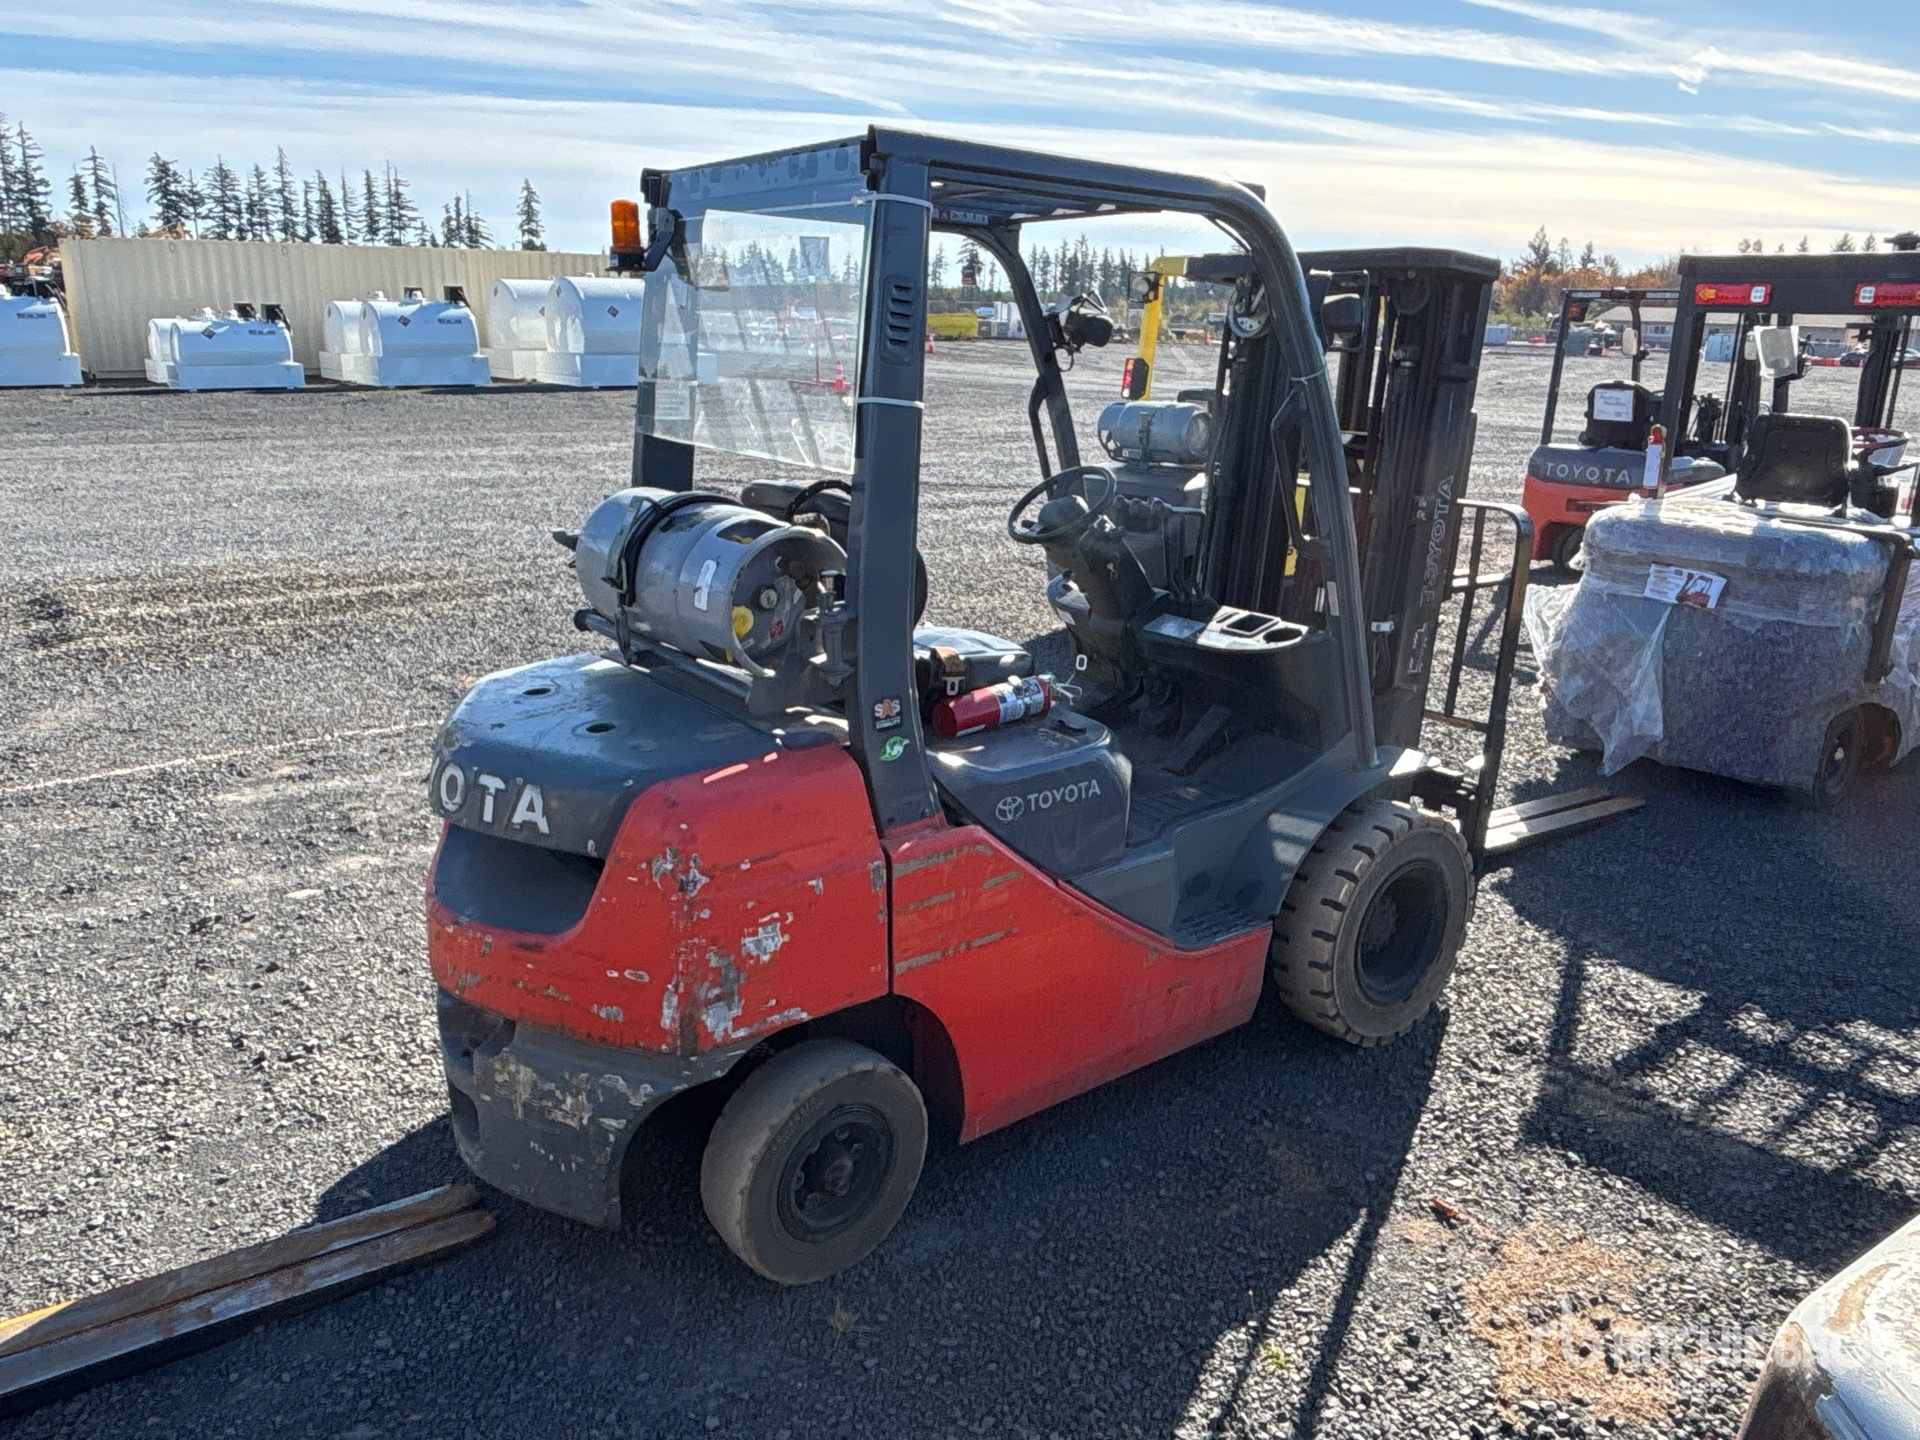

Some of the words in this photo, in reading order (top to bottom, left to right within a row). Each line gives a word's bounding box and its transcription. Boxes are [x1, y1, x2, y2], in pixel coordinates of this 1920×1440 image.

[1545, 461, 1631, 485] TOYOTA
[1419, 474, 1455, 607] TOYOTA
[874, 698, 901, 719] SAS
[429, 756, 550, 834] OTA
[1027, 779, 1101, 812] TOYOTA
